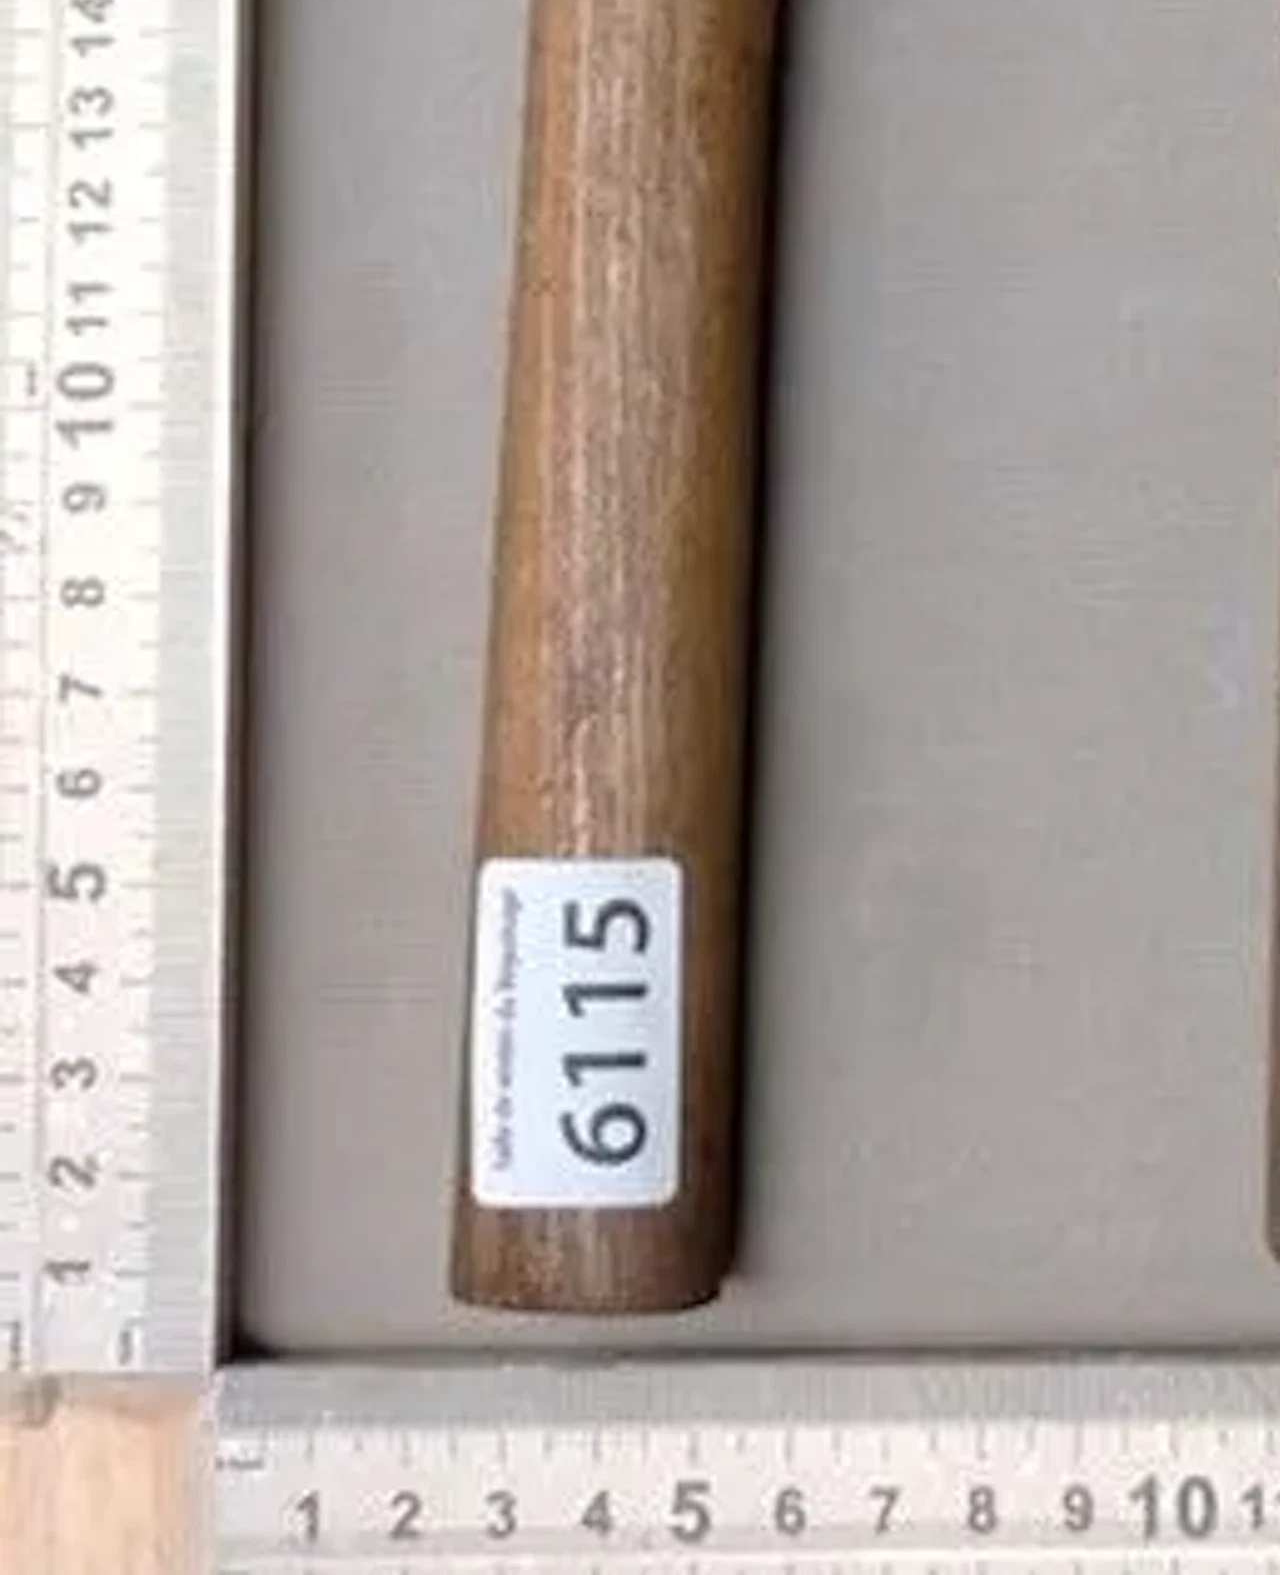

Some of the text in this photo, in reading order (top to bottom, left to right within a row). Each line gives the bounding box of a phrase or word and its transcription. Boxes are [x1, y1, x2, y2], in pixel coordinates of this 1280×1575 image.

[68, 87, 114, 150] 13
[68, 180, 111, 243] 12
[65, 283, 111, 336] 11
[55, 362, 115, 447] 10
[62, 483, 105, 513] 9
[61, 578, 104, 608] 8
[58, 674, 102, 703] 7
[56, 769, 102, 799] 6
[45, 863, 106, 902] 5
[53, 962, 98, 994] 4
[559, 899, 649, 1166] 6115
[50, 1058, 97, 1090] 3
[46, 1157, 99, 1188] 2
[43, 1261, 91, 1283] 1
[297, 1492, 319, 1545] 1
[387, 1491, 423, 1541] 2
[485, 1491, 516, 1540] 3
[581, 1491, 613, 1538] 4
[670, 1481, 711, 1543] 5
[775, 1488, 805, 1537] 6
[870, 1487, 900, 1536] 7
[967, 1486, 998, 1535] 8
[1063, 1486, 1093, 1533] 9
[1130, 1475, 1217, 1541] 10
